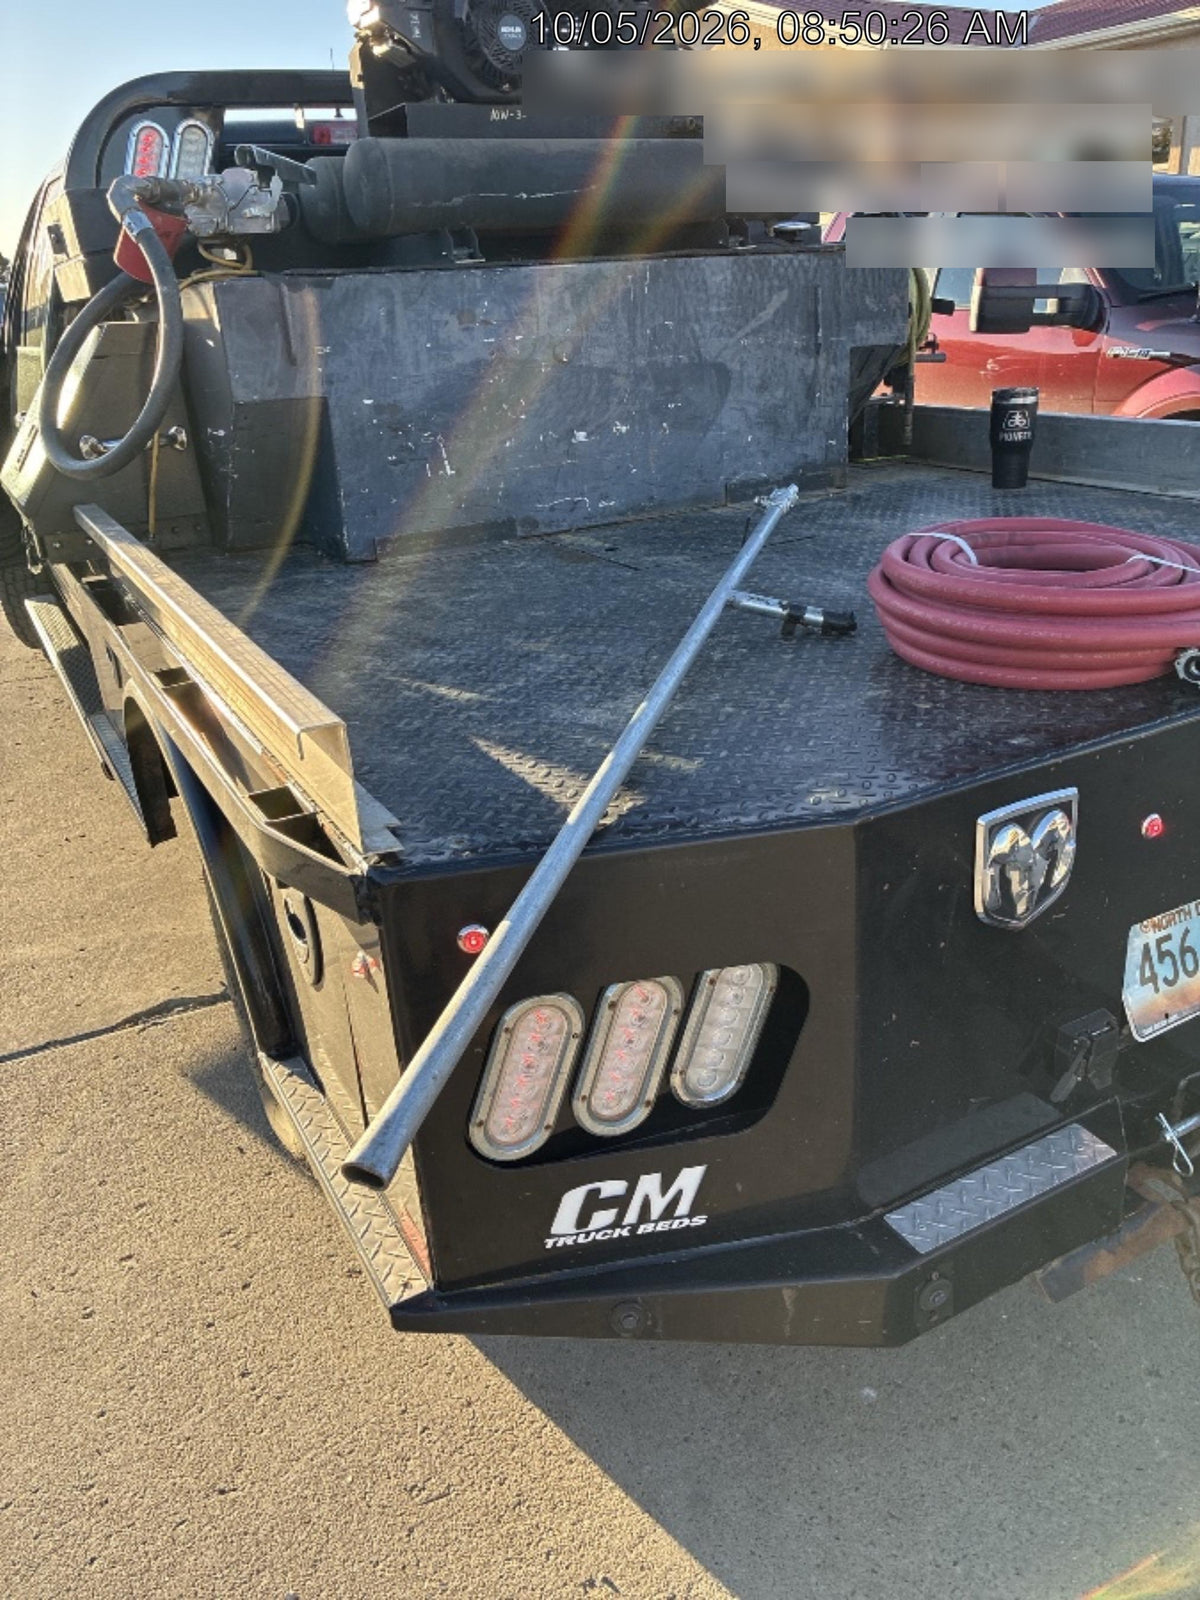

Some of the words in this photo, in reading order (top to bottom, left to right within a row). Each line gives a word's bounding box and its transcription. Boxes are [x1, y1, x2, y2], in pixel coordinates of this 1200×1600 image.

[1151, 904, 1193, 934] NORTH
[1139, 926, 1199, 994] 456
[550, 1164, 708, 1235] CM
[544, 1226, 631, 1249] TRUCK
[636, 1214, 709, 1235] BEDS
